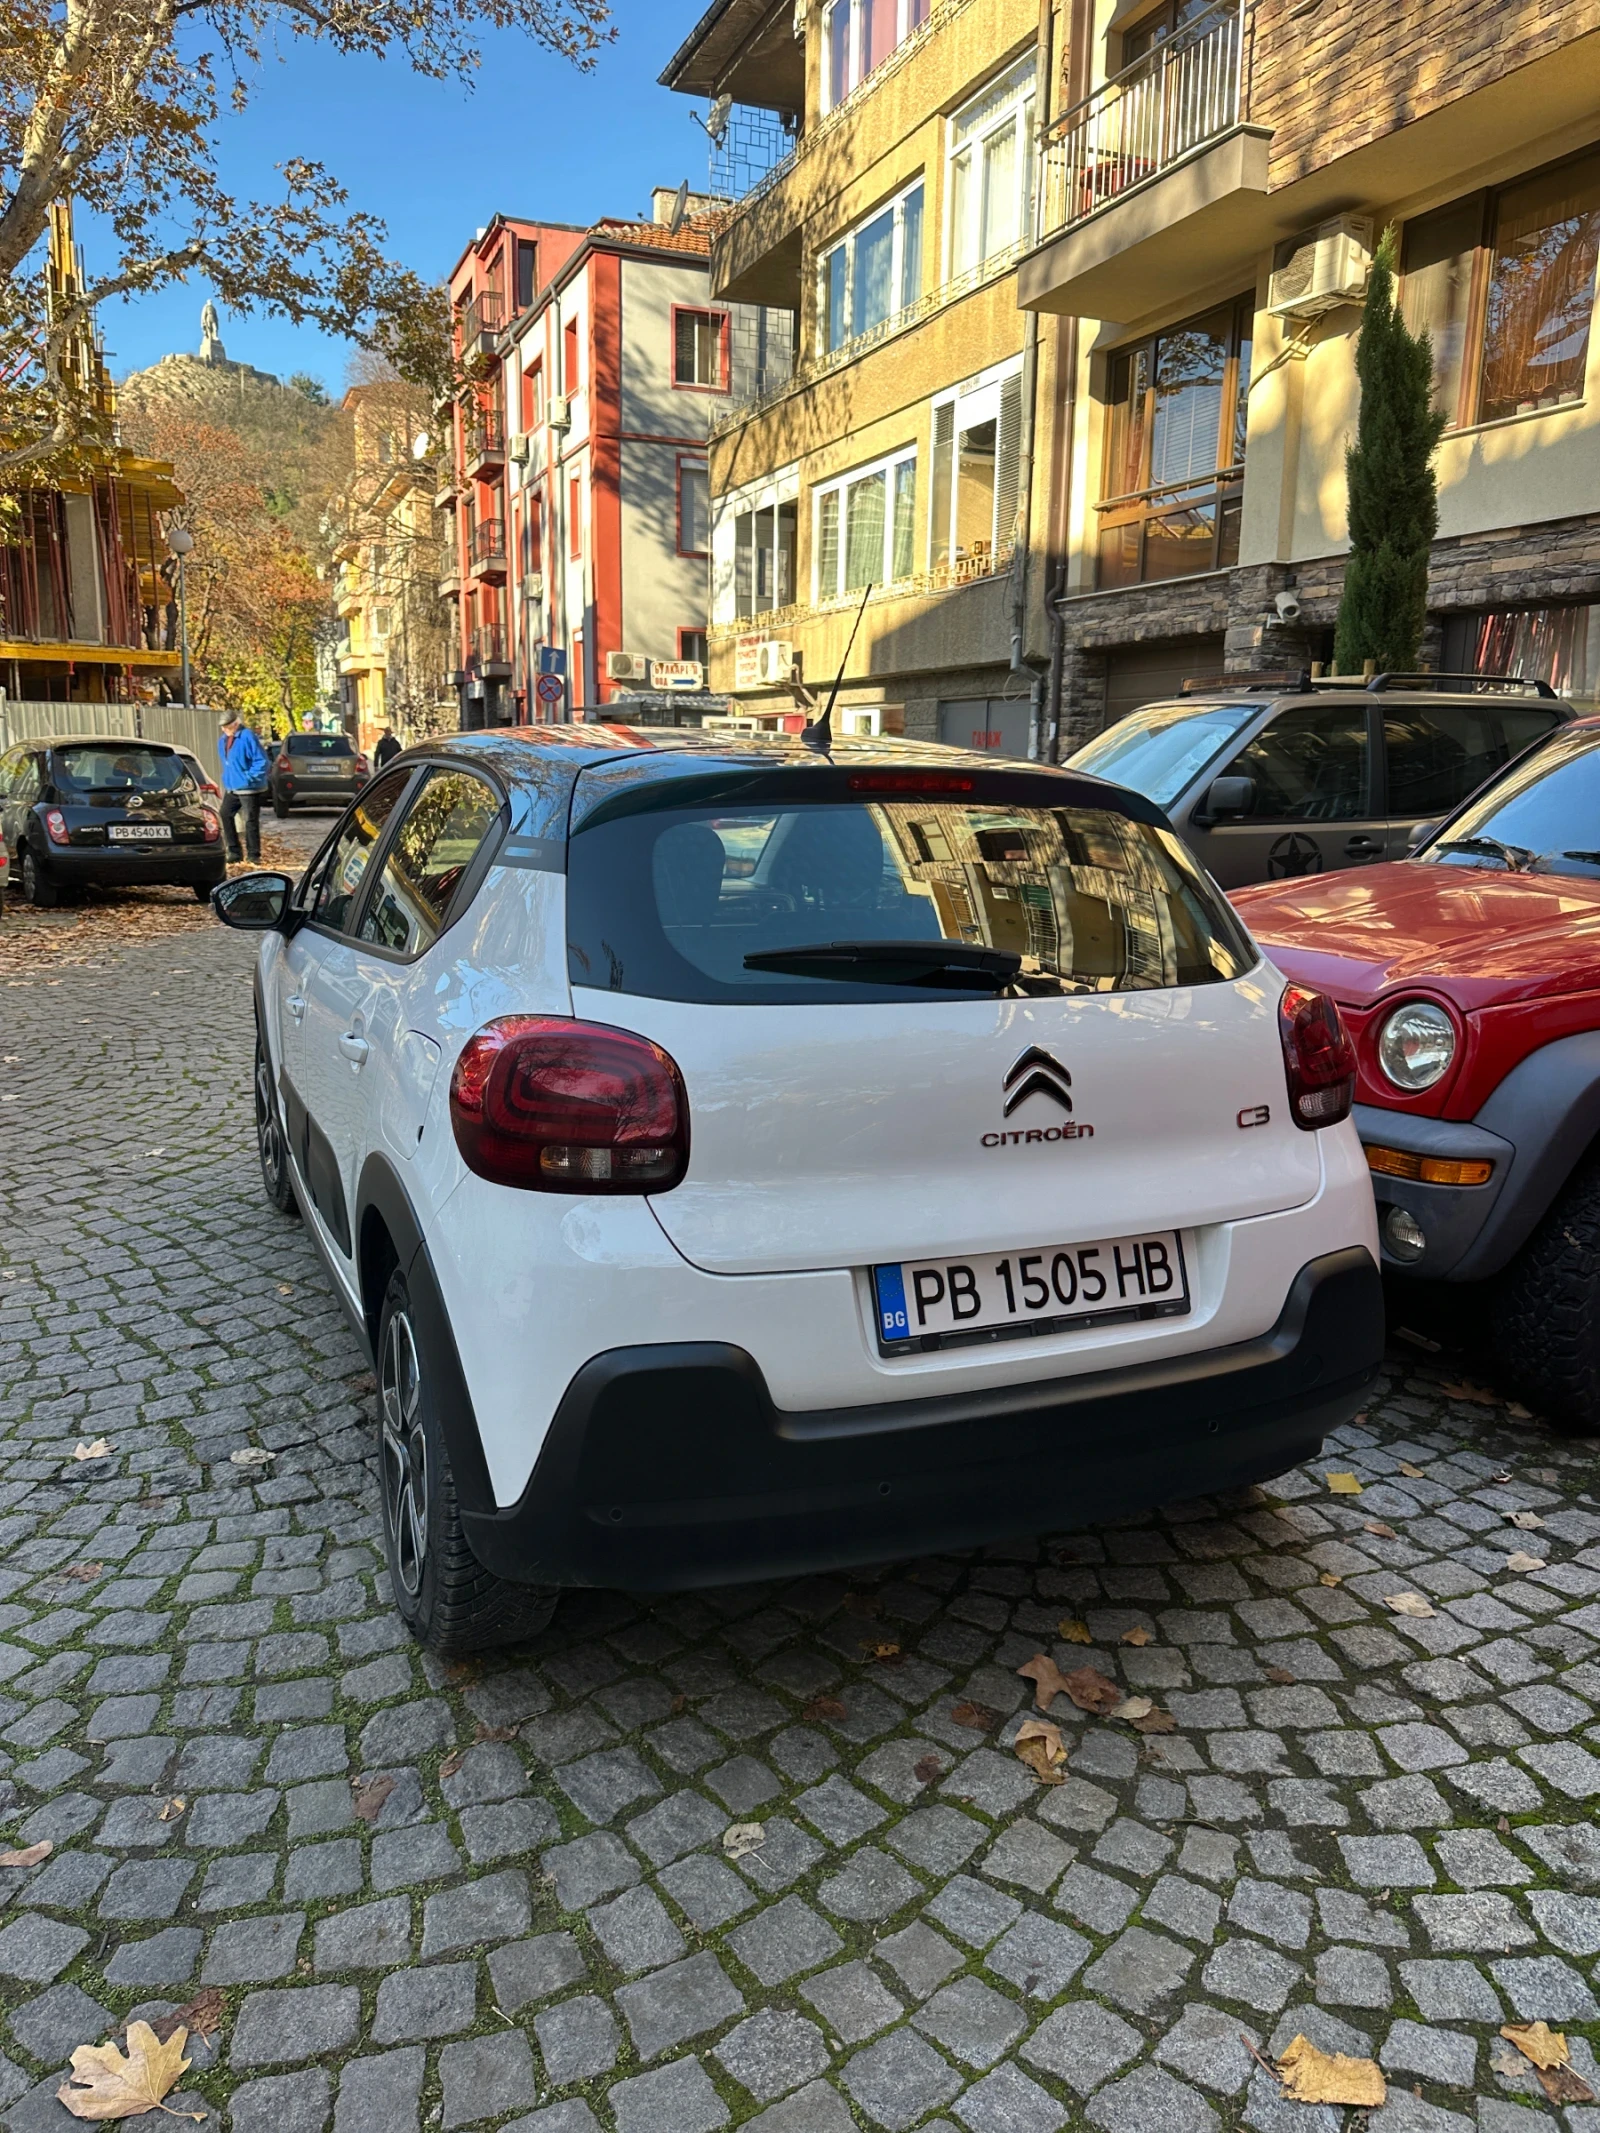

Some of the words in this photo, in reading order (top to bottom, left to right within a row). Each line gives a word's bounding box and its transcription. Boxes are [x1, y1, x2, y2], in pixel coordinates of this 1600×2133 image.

[131, 827, 155, 837] 4540
[1236, 1105, 1271, 1129] C3
[912, 1265, 981, 1326] PB
[995, 1249, 1107, 1313] 1505
[1112, 1241, 1174, 1298] HB
[883, 1311, 906, 1329] BG
